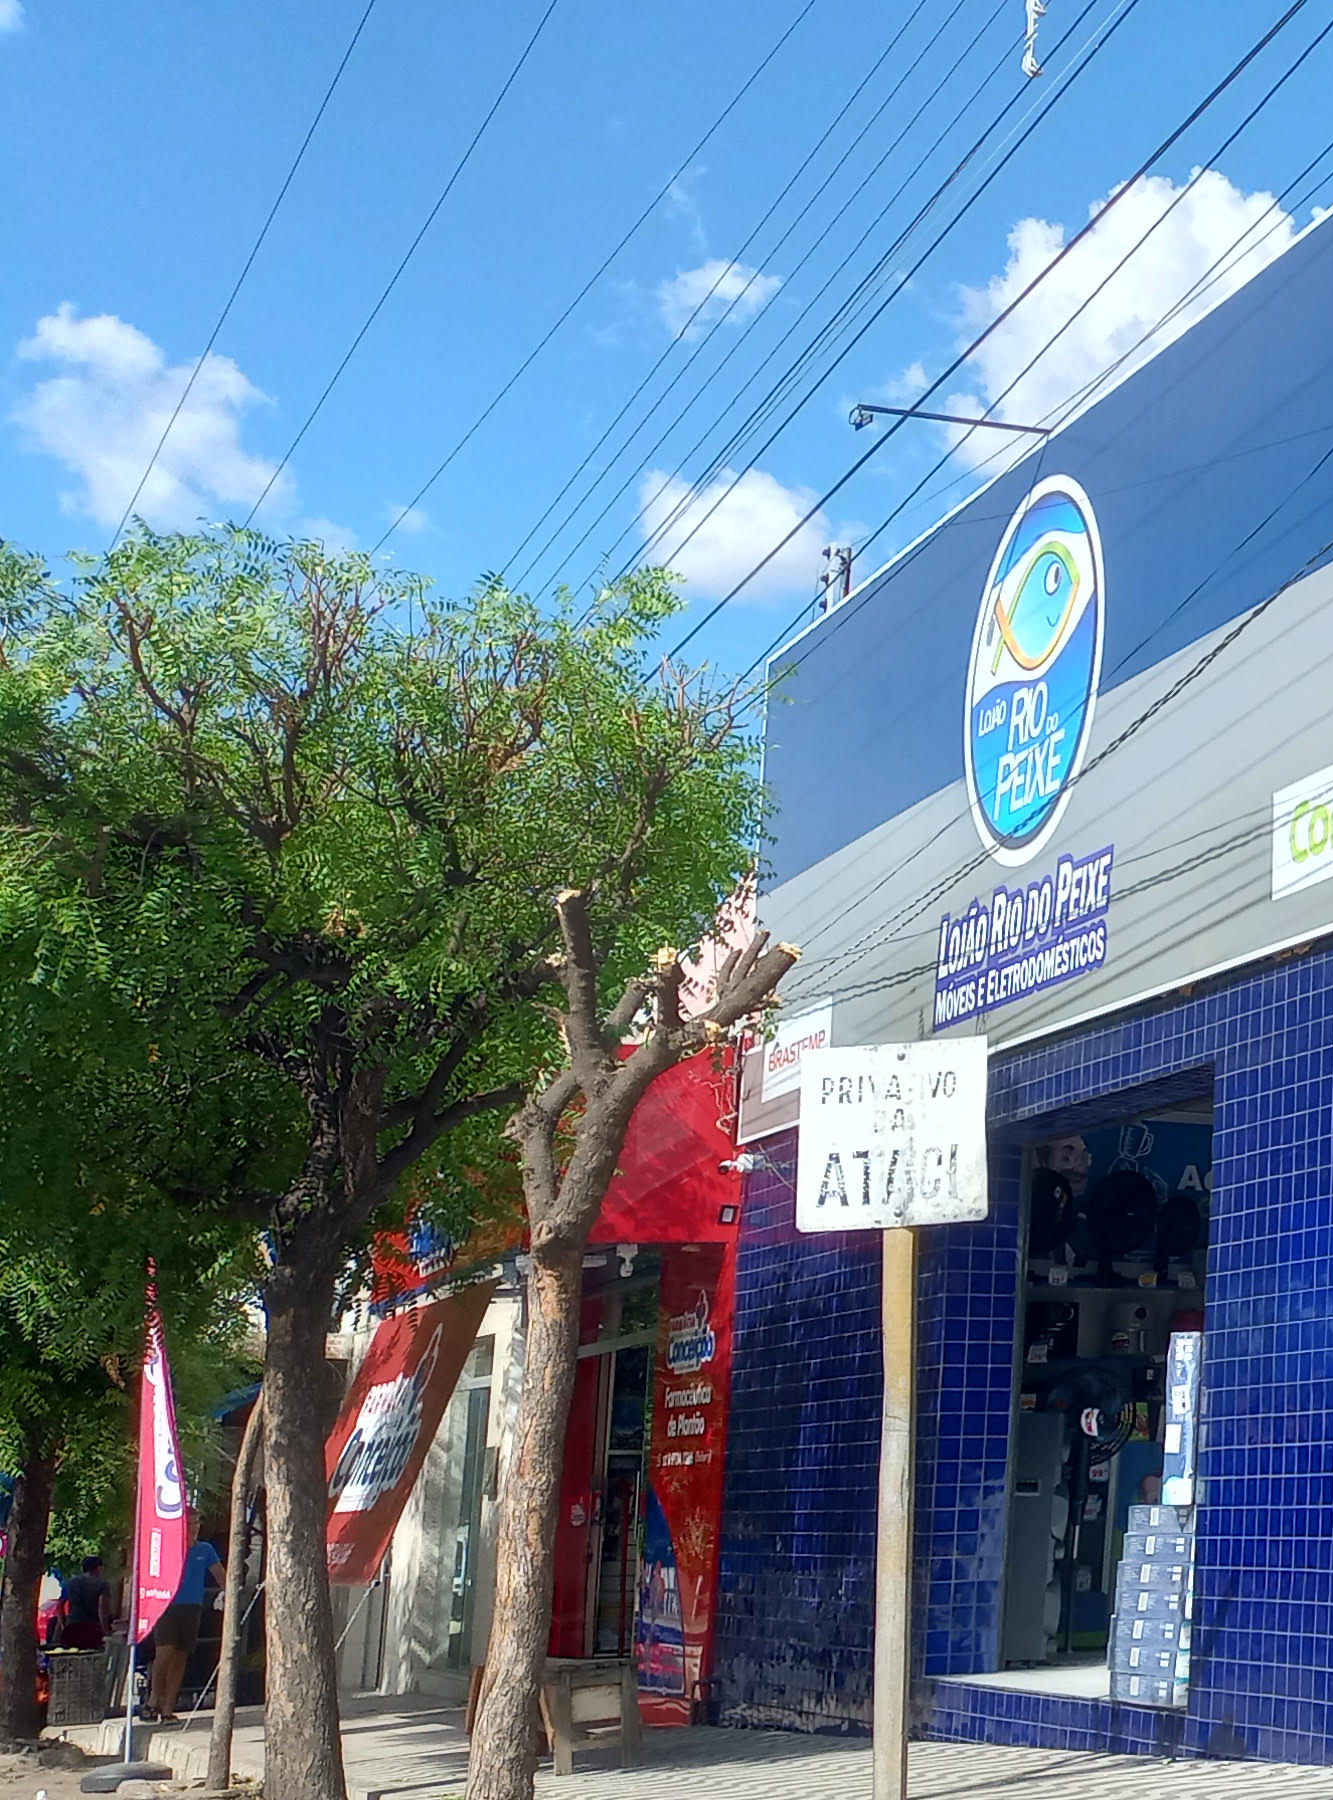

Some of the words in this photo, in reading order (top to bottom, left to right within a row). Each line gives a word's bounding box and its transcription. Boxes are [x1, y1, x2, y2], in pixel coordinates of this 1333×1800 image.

[978, 696, 1008, 738] LOJÃO
[1008, 681, 1049, 752] RIO
[1046, 711, 1060, 737] DO
[992, 727, 1066, 821] PEIXE
[976, 976, 987, 1008] E
[768, 1029, 826, 1073] BRASTEMP
[821, 1070, 957, 1105] PRIVAVO
